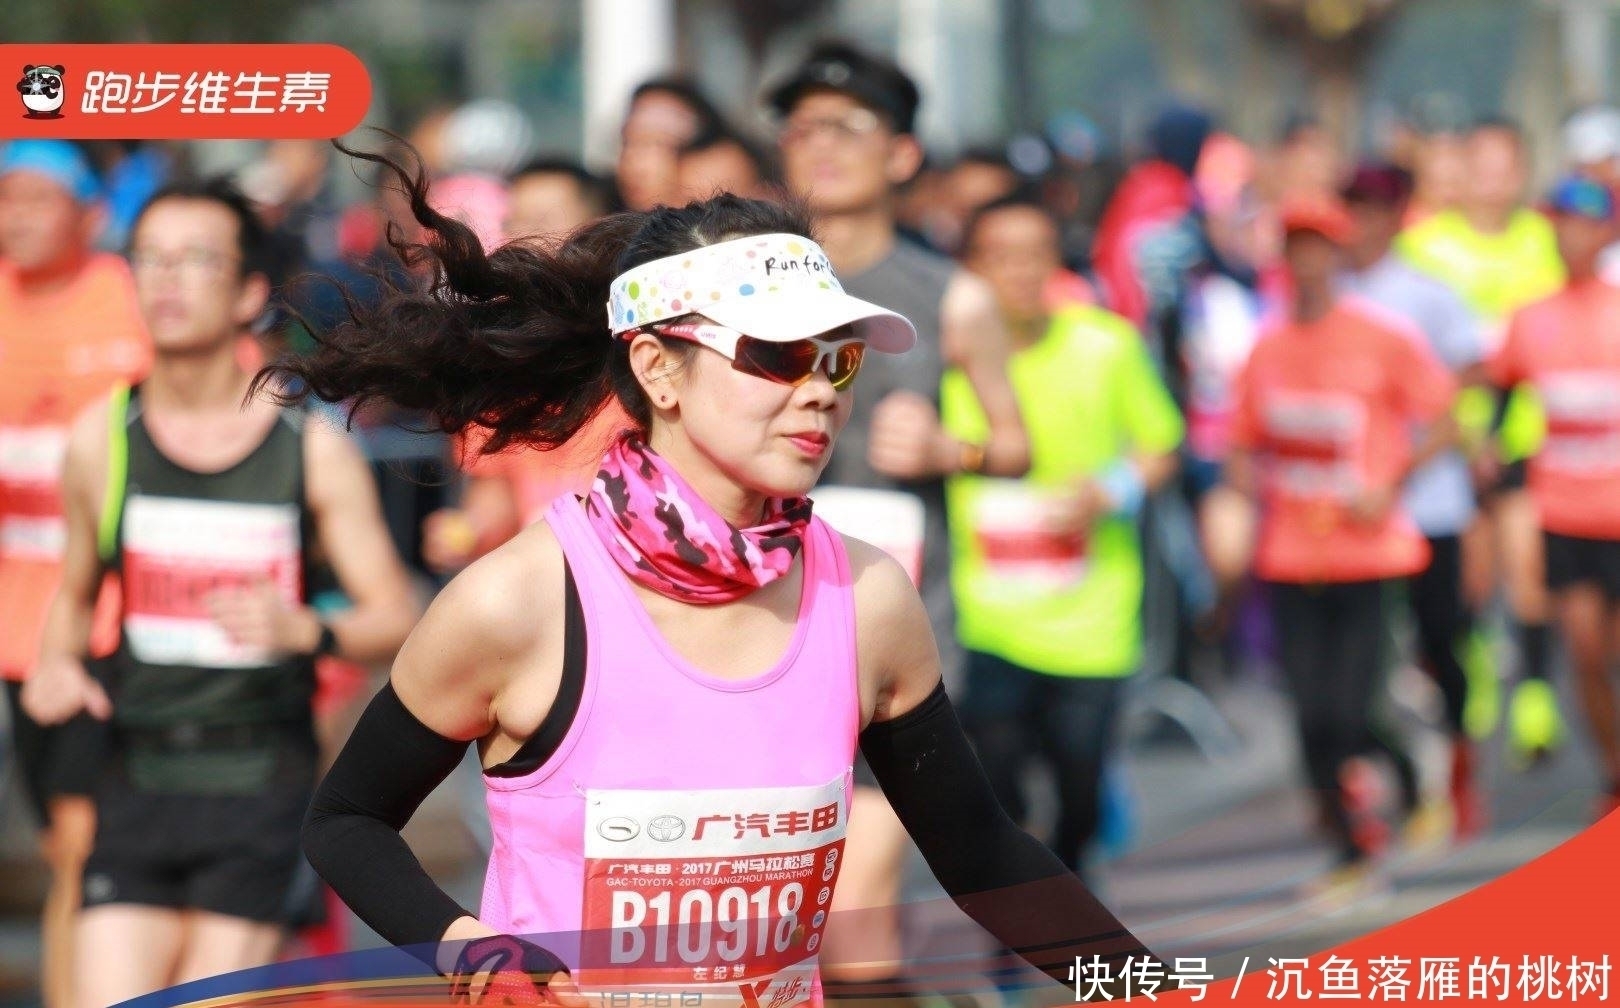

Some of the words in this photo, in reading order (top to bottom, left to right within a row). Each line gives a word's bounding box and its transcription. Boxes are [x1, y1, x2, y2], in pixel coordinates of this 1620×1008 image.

[765, 257, 800, 276] Run
[803, 255, 825, 276] for
[692, 802, 838, 840] 广汽丰田
[680, 878, 701, 887] 2017
[703, 873, 762, 887] GUANGZHOU
[765, 868, 813, 881] MARATHON
[610, 882, 804, 964] B10918
